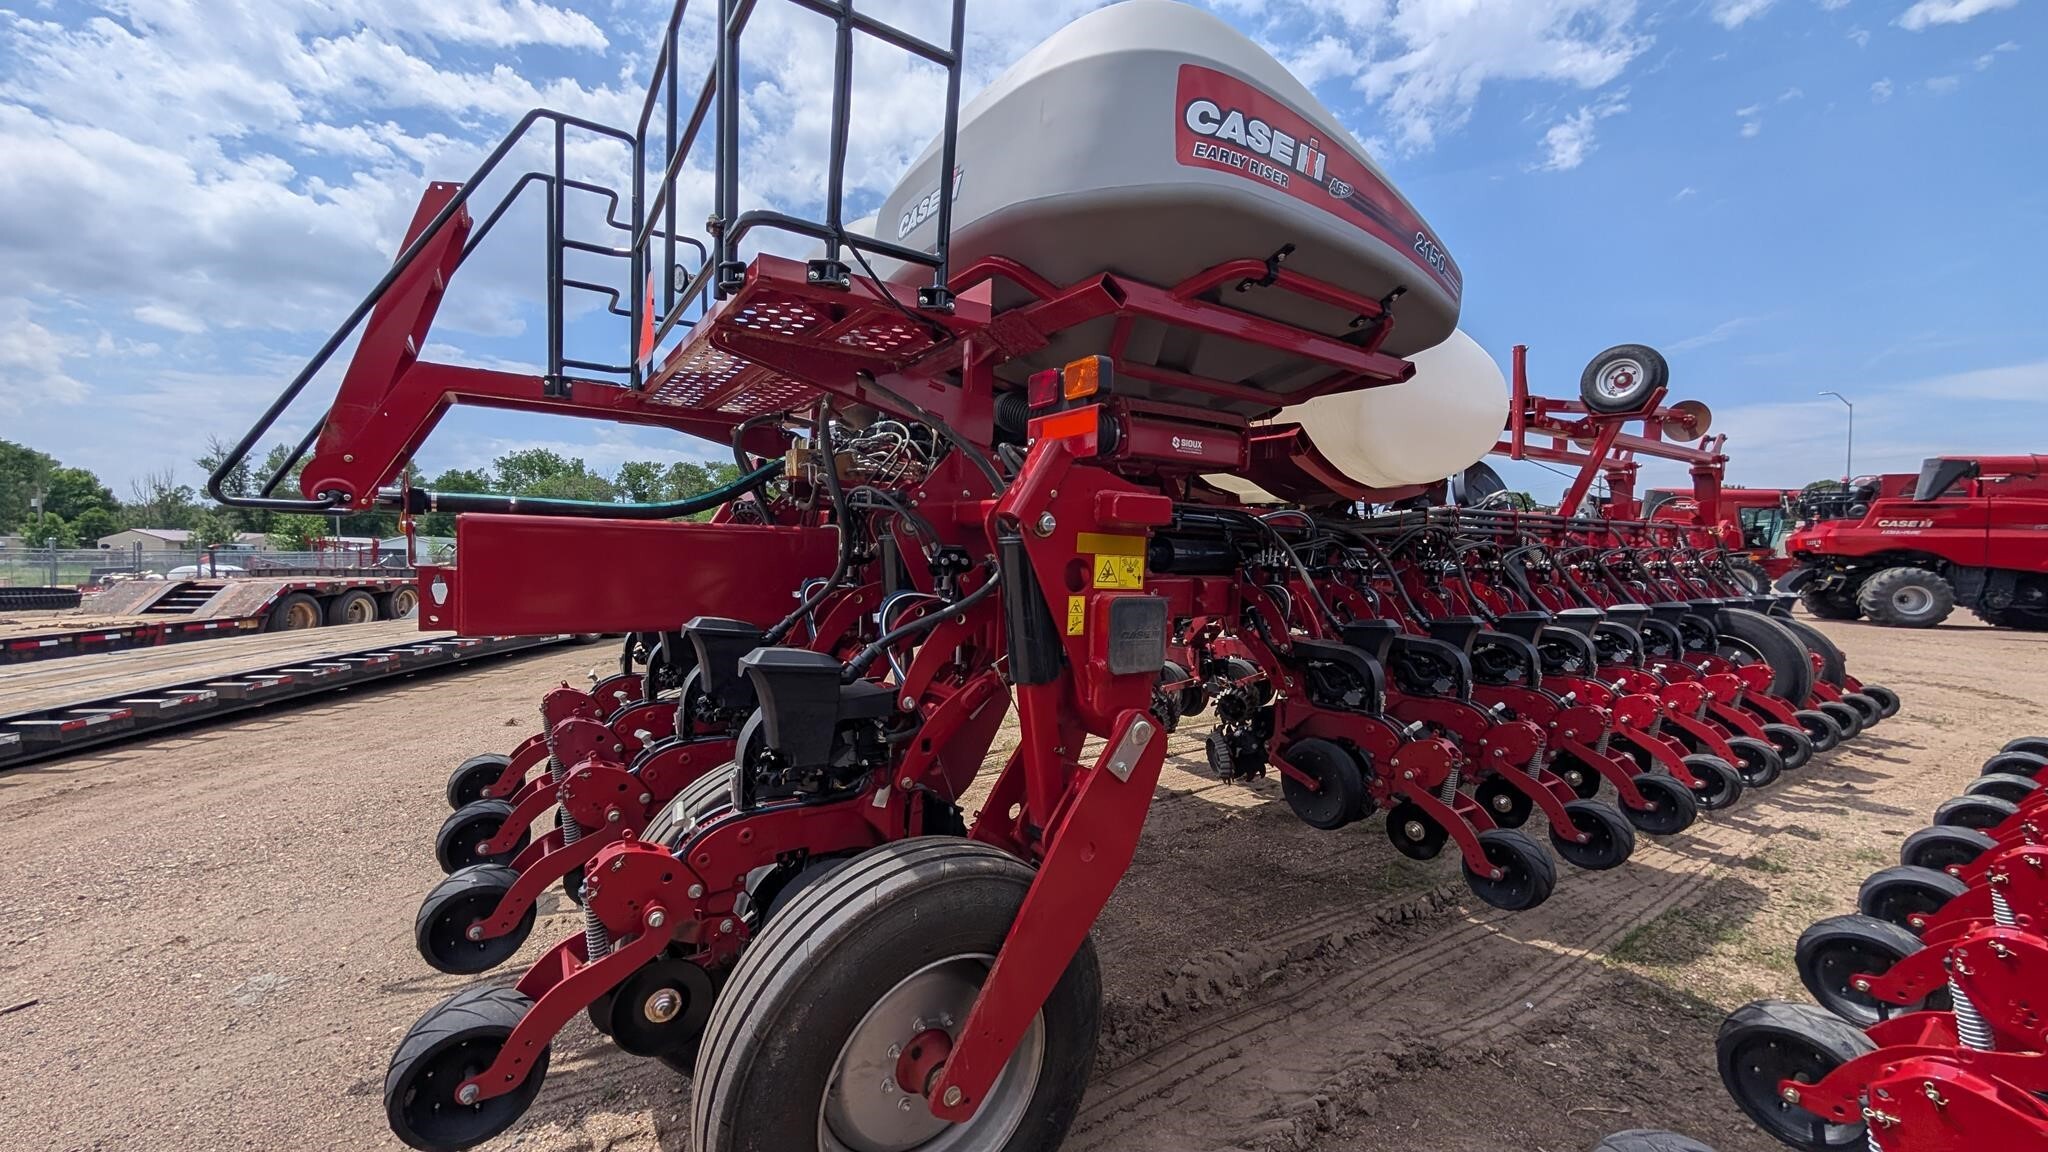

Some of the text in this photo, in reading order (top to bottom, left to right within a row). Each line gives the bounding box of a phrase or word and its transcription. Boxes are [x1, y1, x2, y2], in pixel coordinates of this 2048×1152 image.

[1186, 100, 1295, 167] CASE
[1192, 141, 1290, 188] EARLY RISER
[1329, 177, 1351, 198] AFS
[898, 187, 941, 241] CASE
[1414, 231, 1446, 276] 2150
[1181, 438, 1203, 449] SIOUX
[1878, 519, 1919, 528] CASE
